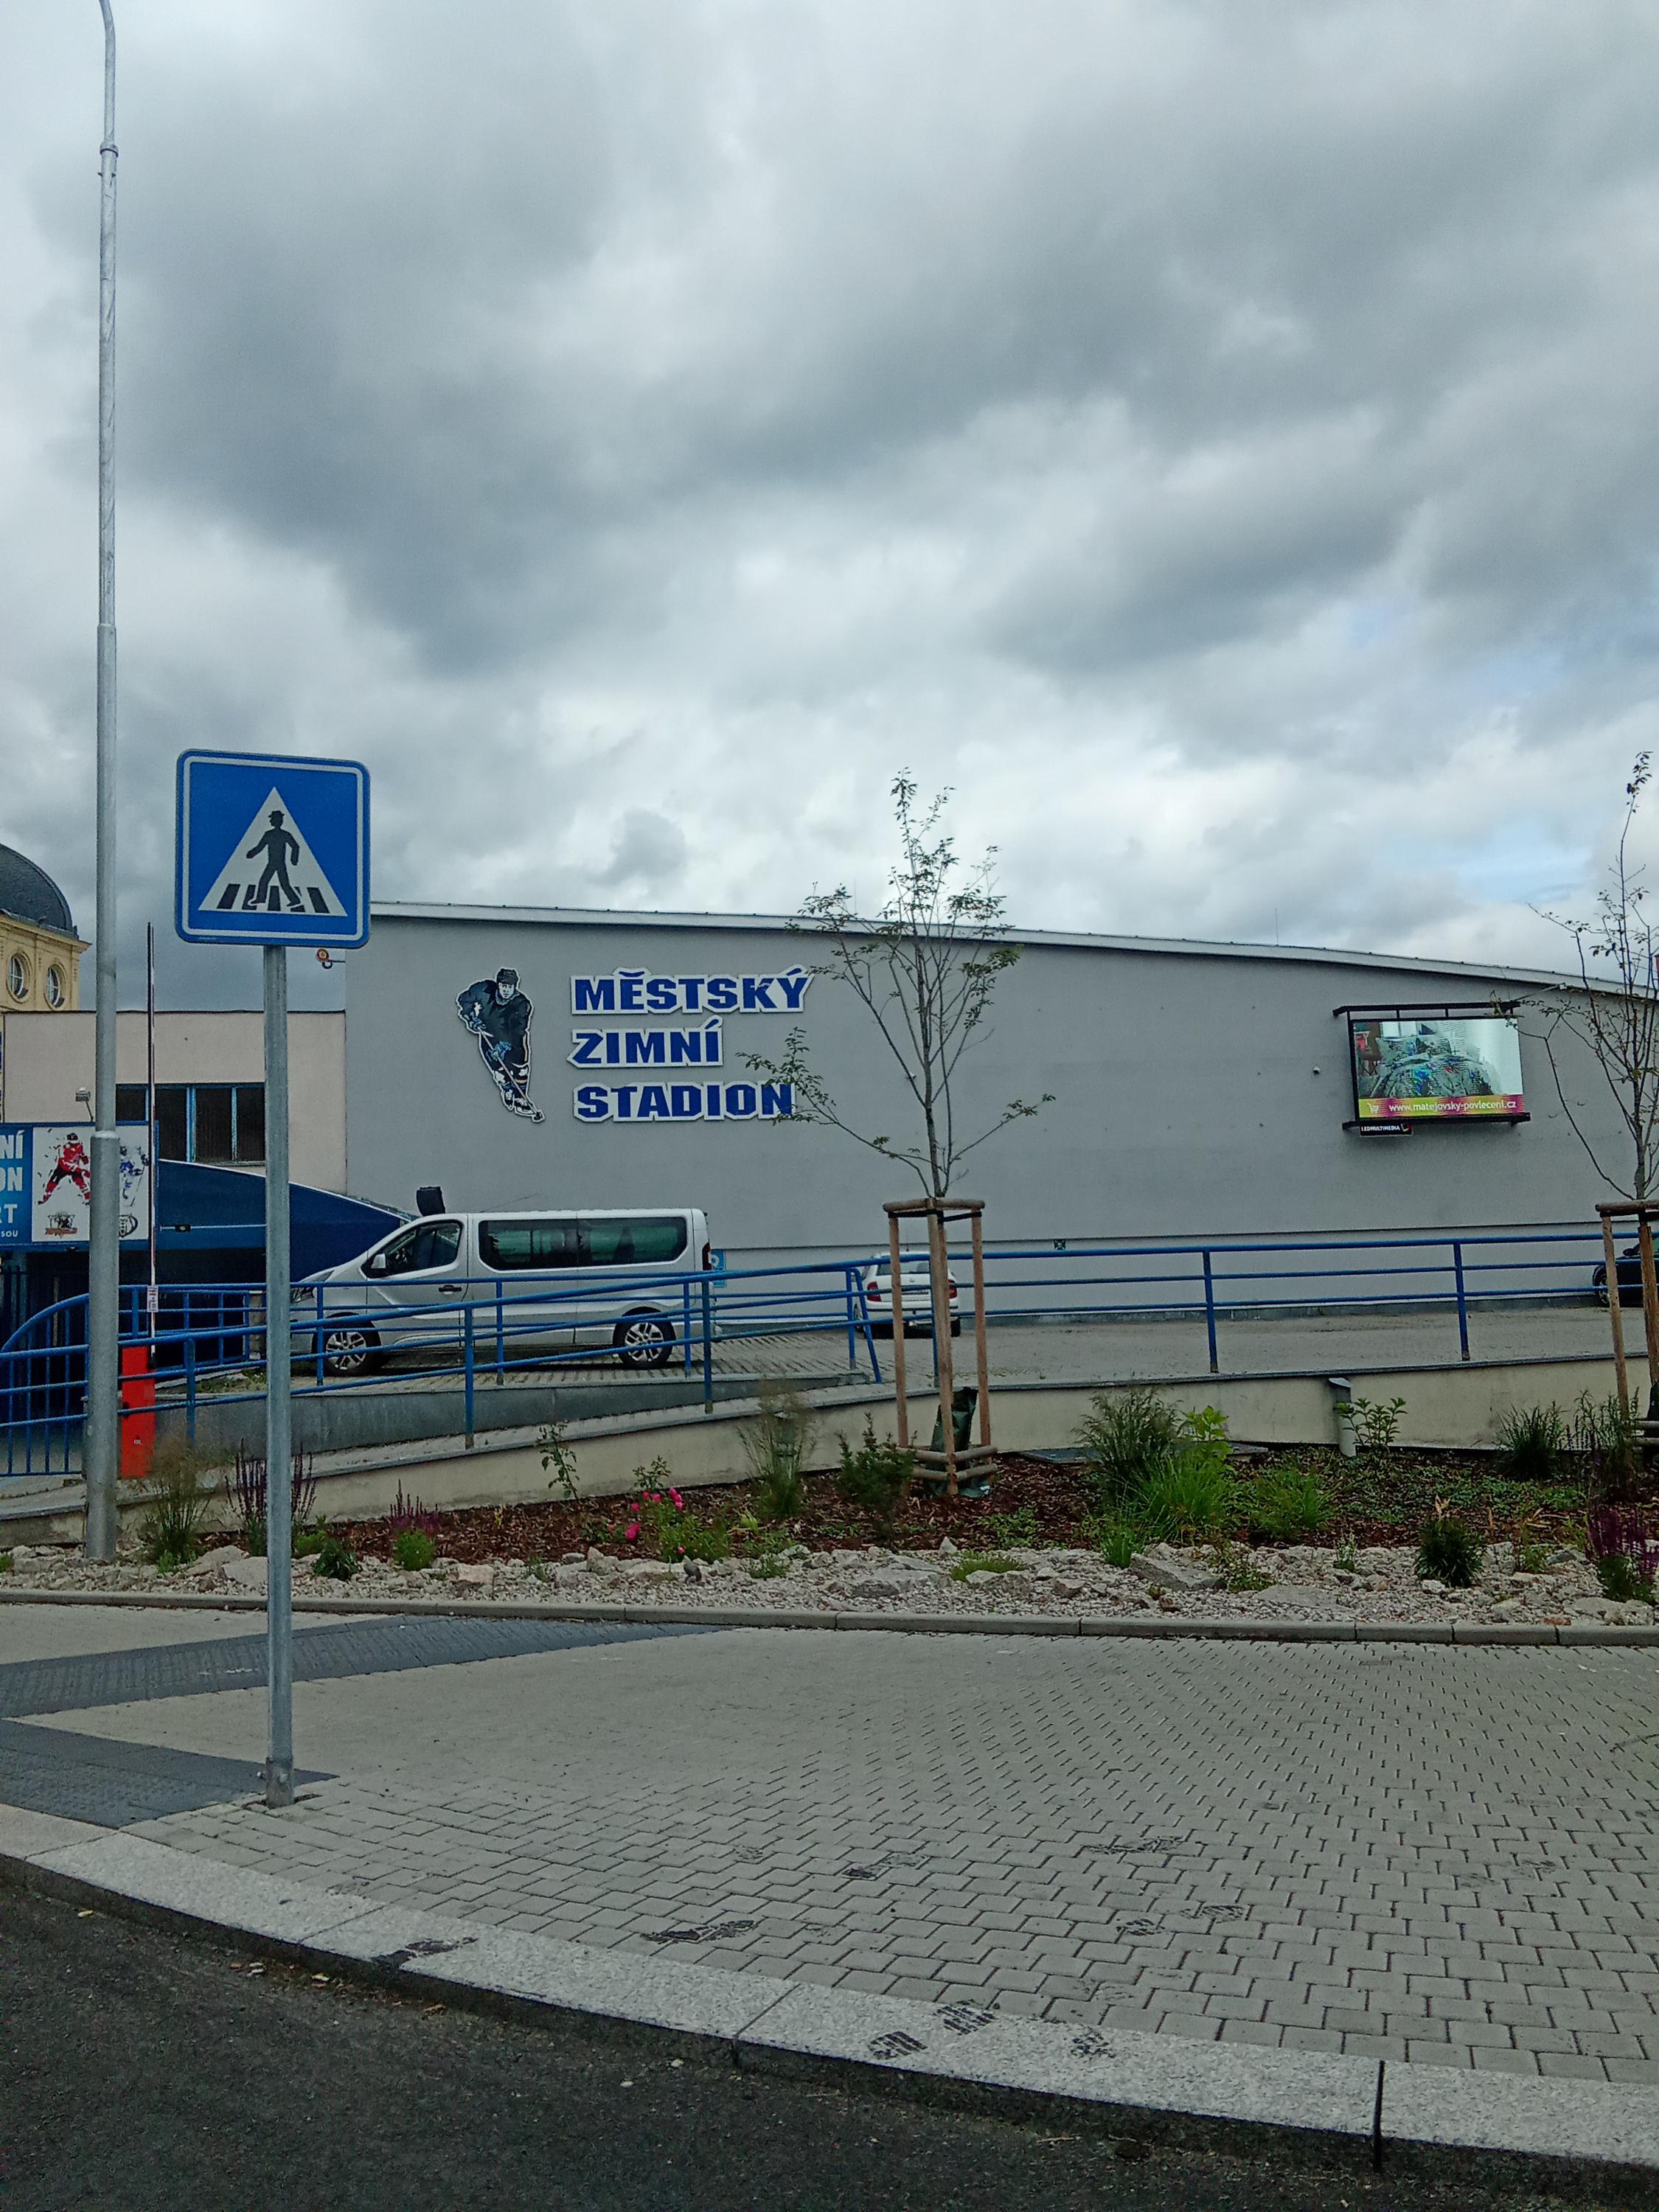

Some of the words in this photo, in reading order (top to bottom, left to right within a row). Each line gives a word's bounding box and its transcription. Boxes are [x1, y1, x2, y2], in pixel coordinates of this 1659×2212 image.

[574, 967, 807, 1011] MĚSTSKÝ
[572, 1019, 720, 1064] ZIMNÍ
[577, 1085, 796, 1119] STADION
